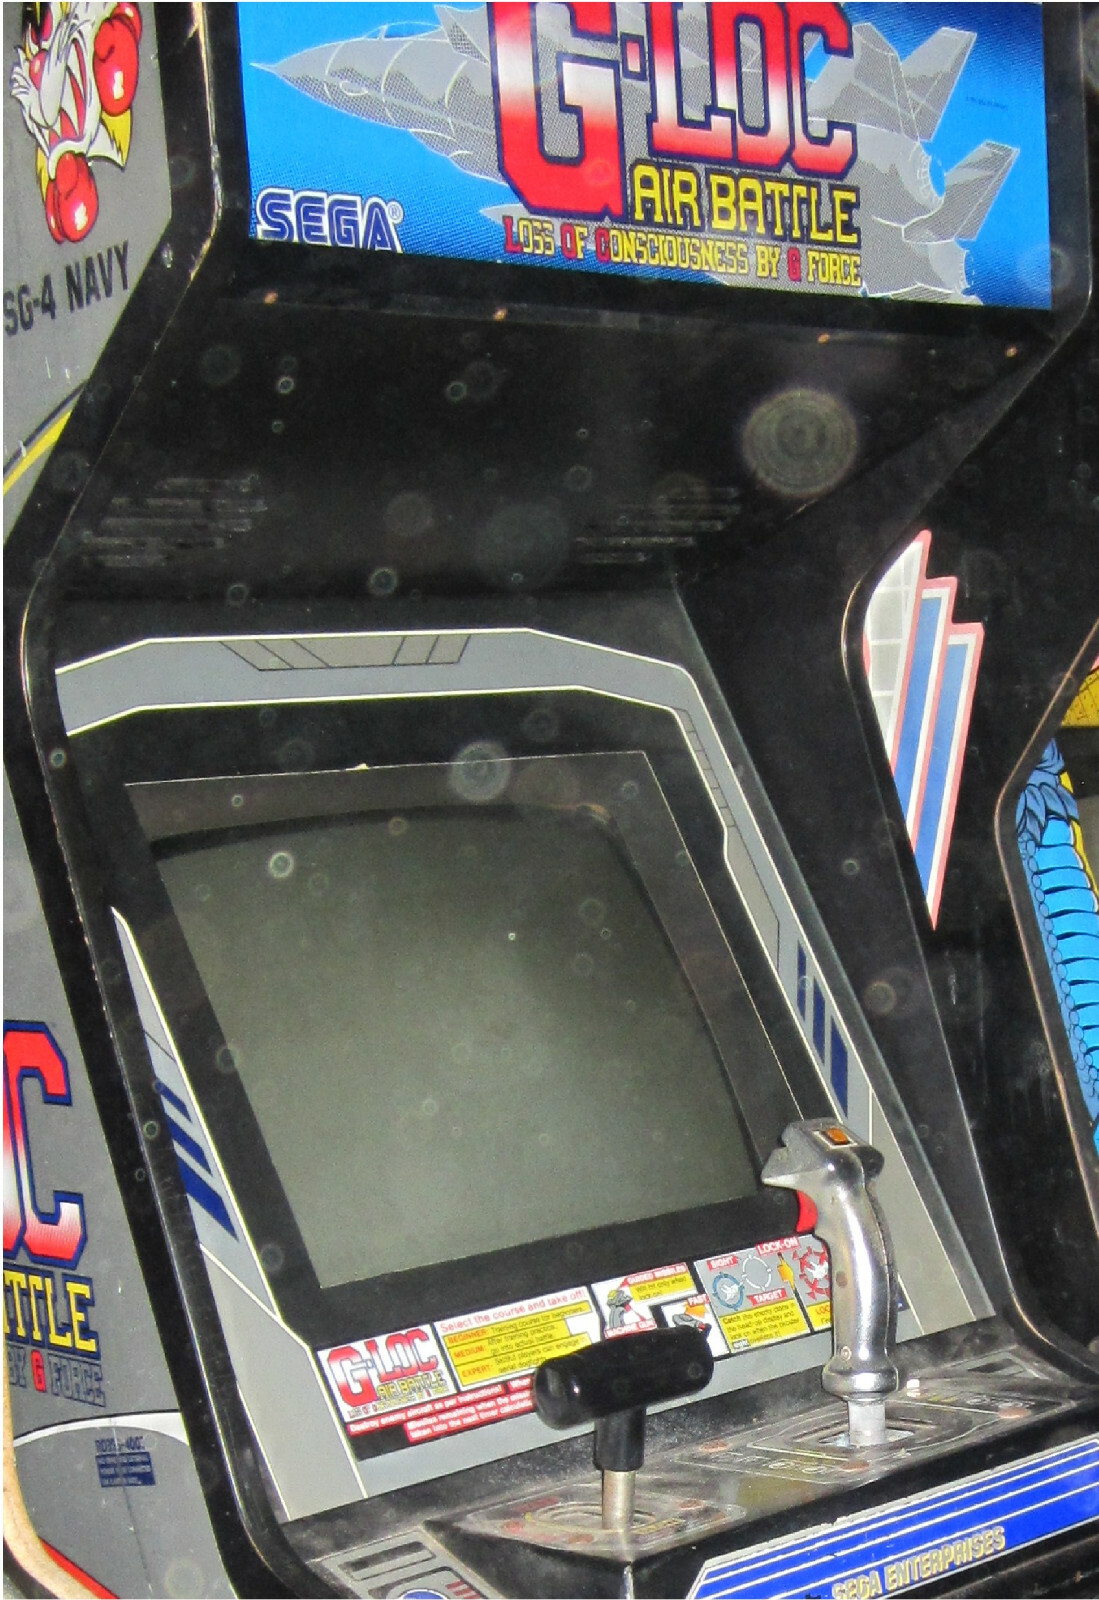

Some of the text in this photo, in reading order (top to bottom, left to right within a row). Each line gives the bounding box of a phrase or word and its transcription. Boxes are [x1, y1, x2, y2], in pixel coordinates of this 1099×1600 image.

[631, 161, 861, 247] AIR BATTLE
[65, 240, 128, 313] NAVY
[755, 244, 781, 279] BY
[787, 247, 802, 282] G
[807, 250, 862, 287] FORCE
[757, 1237, 799, 1255] LOCK-ON
[3, 1264, 100, 1358] TTLE
[440, 1289, 586, 1333] Select the course and take off!
[687, 1294, 708, 1306] FAST
[753, 1290, 784, 1305] TARGET
[30, 1349, 47, 1393] G
[48, 1353, 107, 1408] FORCE
[831, 1526, 1006, 1599] SEGA ENTERPRISES
